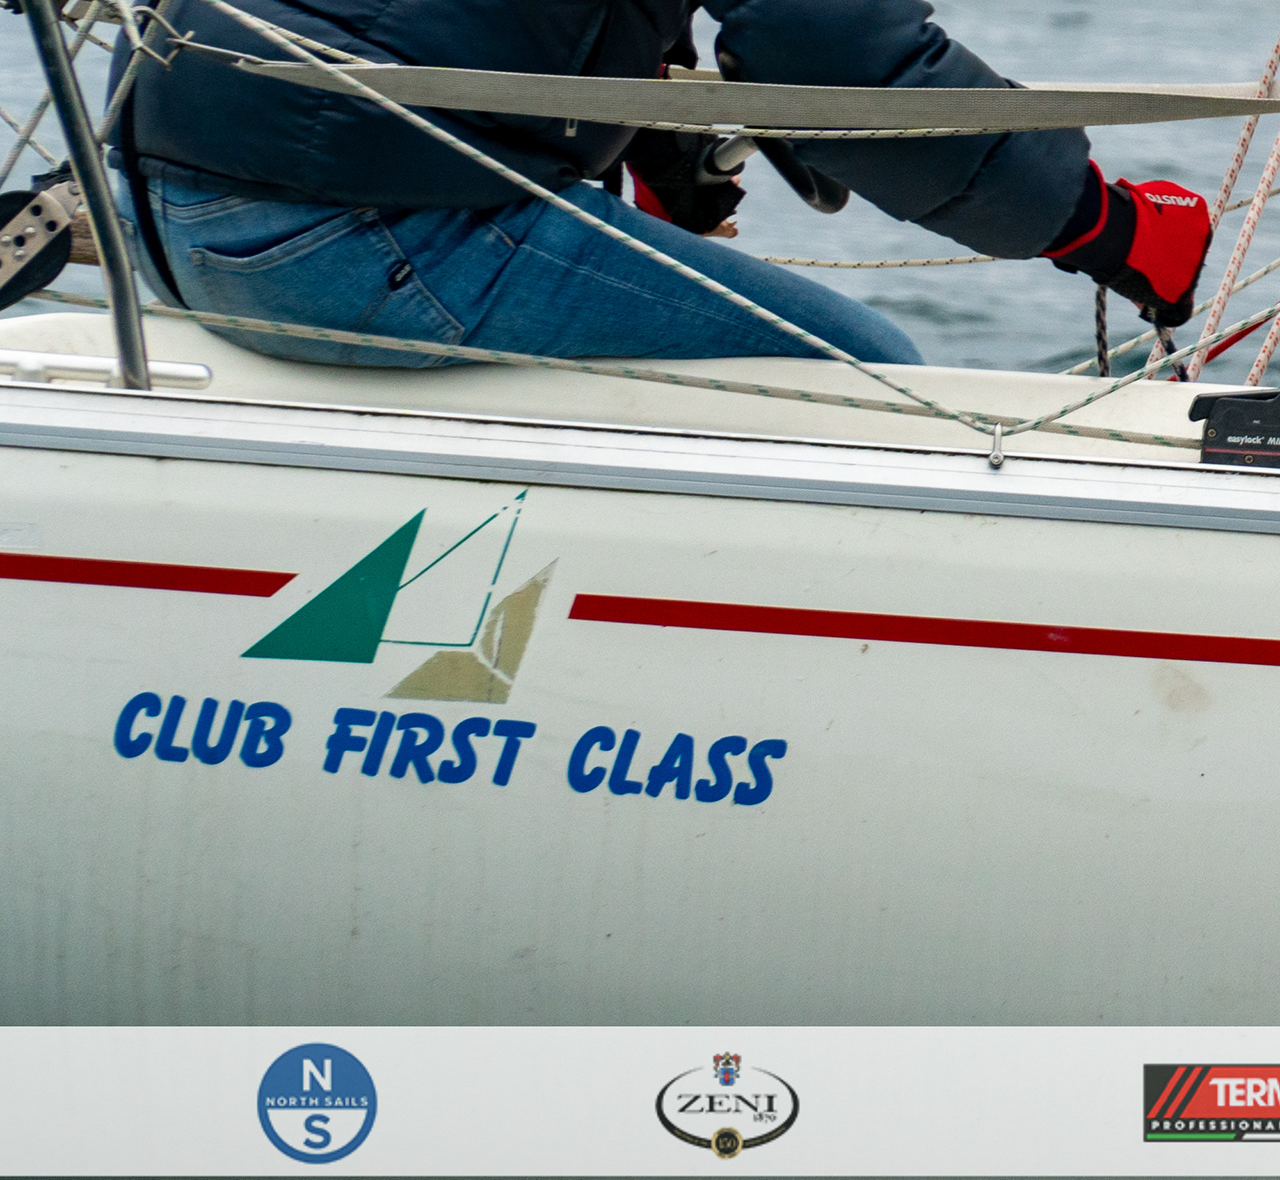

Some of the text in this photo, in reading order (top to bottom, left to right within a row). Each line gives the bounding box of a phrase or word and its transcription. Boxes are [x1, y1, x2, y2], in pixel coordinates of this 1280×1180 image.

[1145, 193, 1198, 207] MUSTO
[114, 692, 788, 806] CLUB FIRST CLASS
